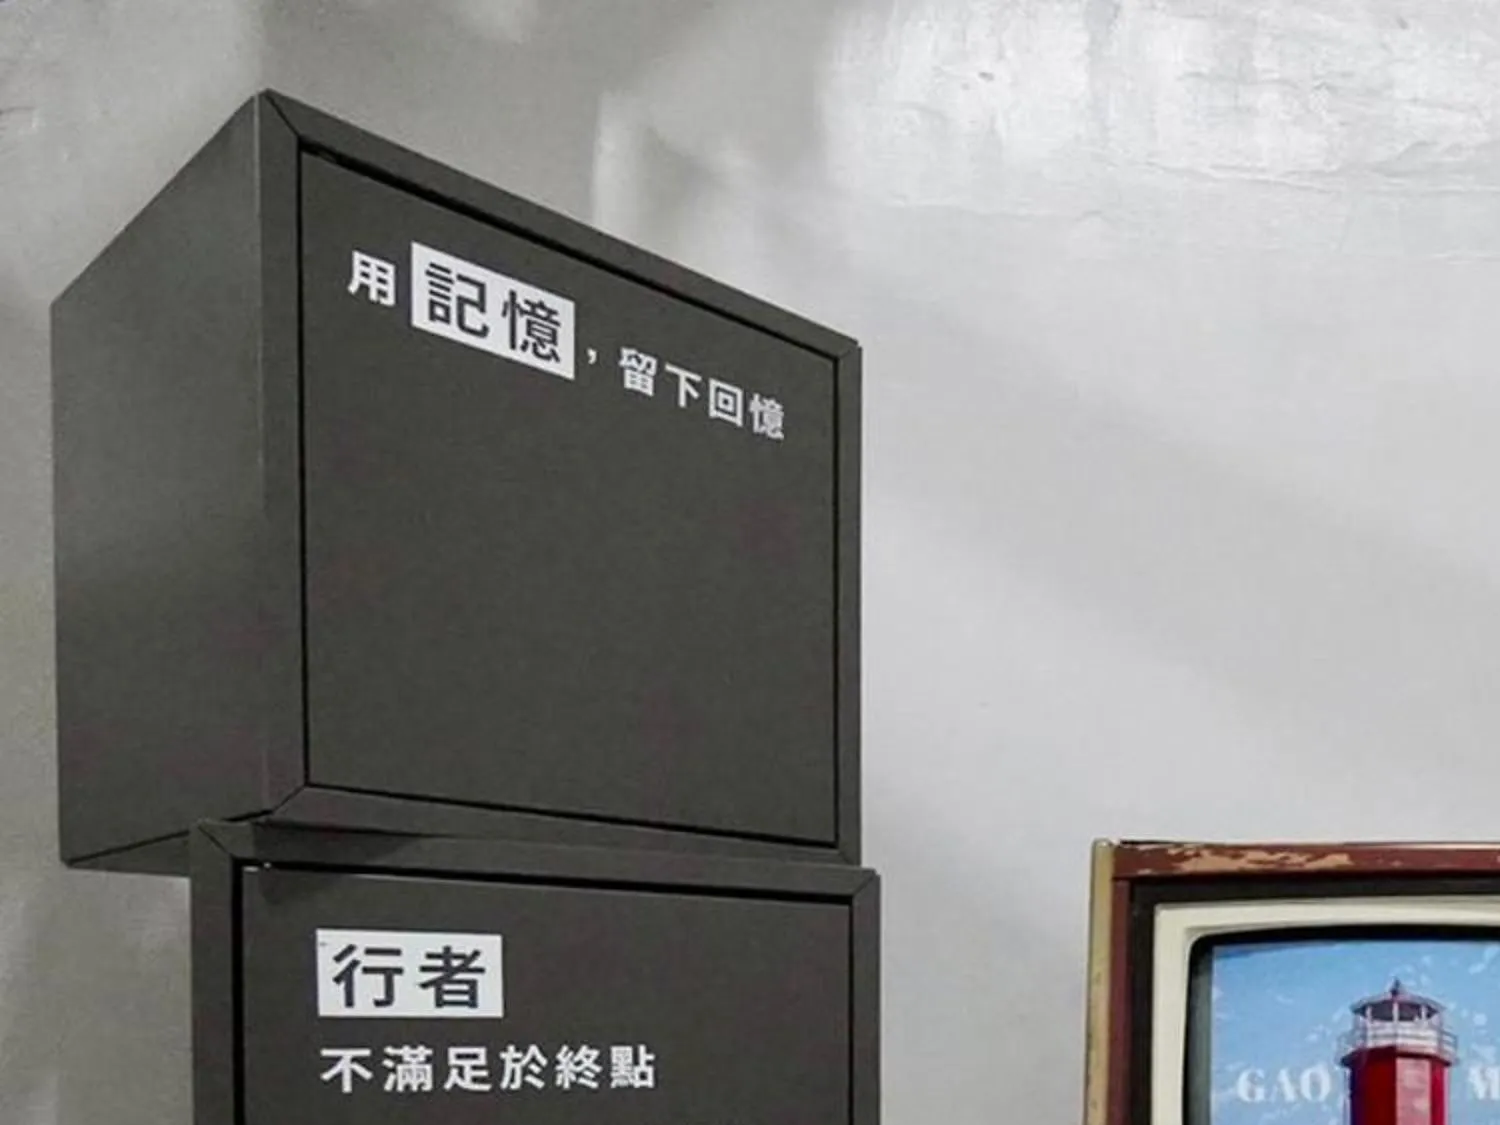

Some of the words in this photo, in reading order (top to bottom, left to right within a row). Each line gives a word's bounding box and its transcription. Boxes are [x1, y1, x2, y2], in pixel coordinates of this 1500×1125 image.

[332, 943, 486, 1009] 行者
[320, 1044, 655, 1093] 不滿足於終點
[1237, 1063, 1331, 1101] GAO
